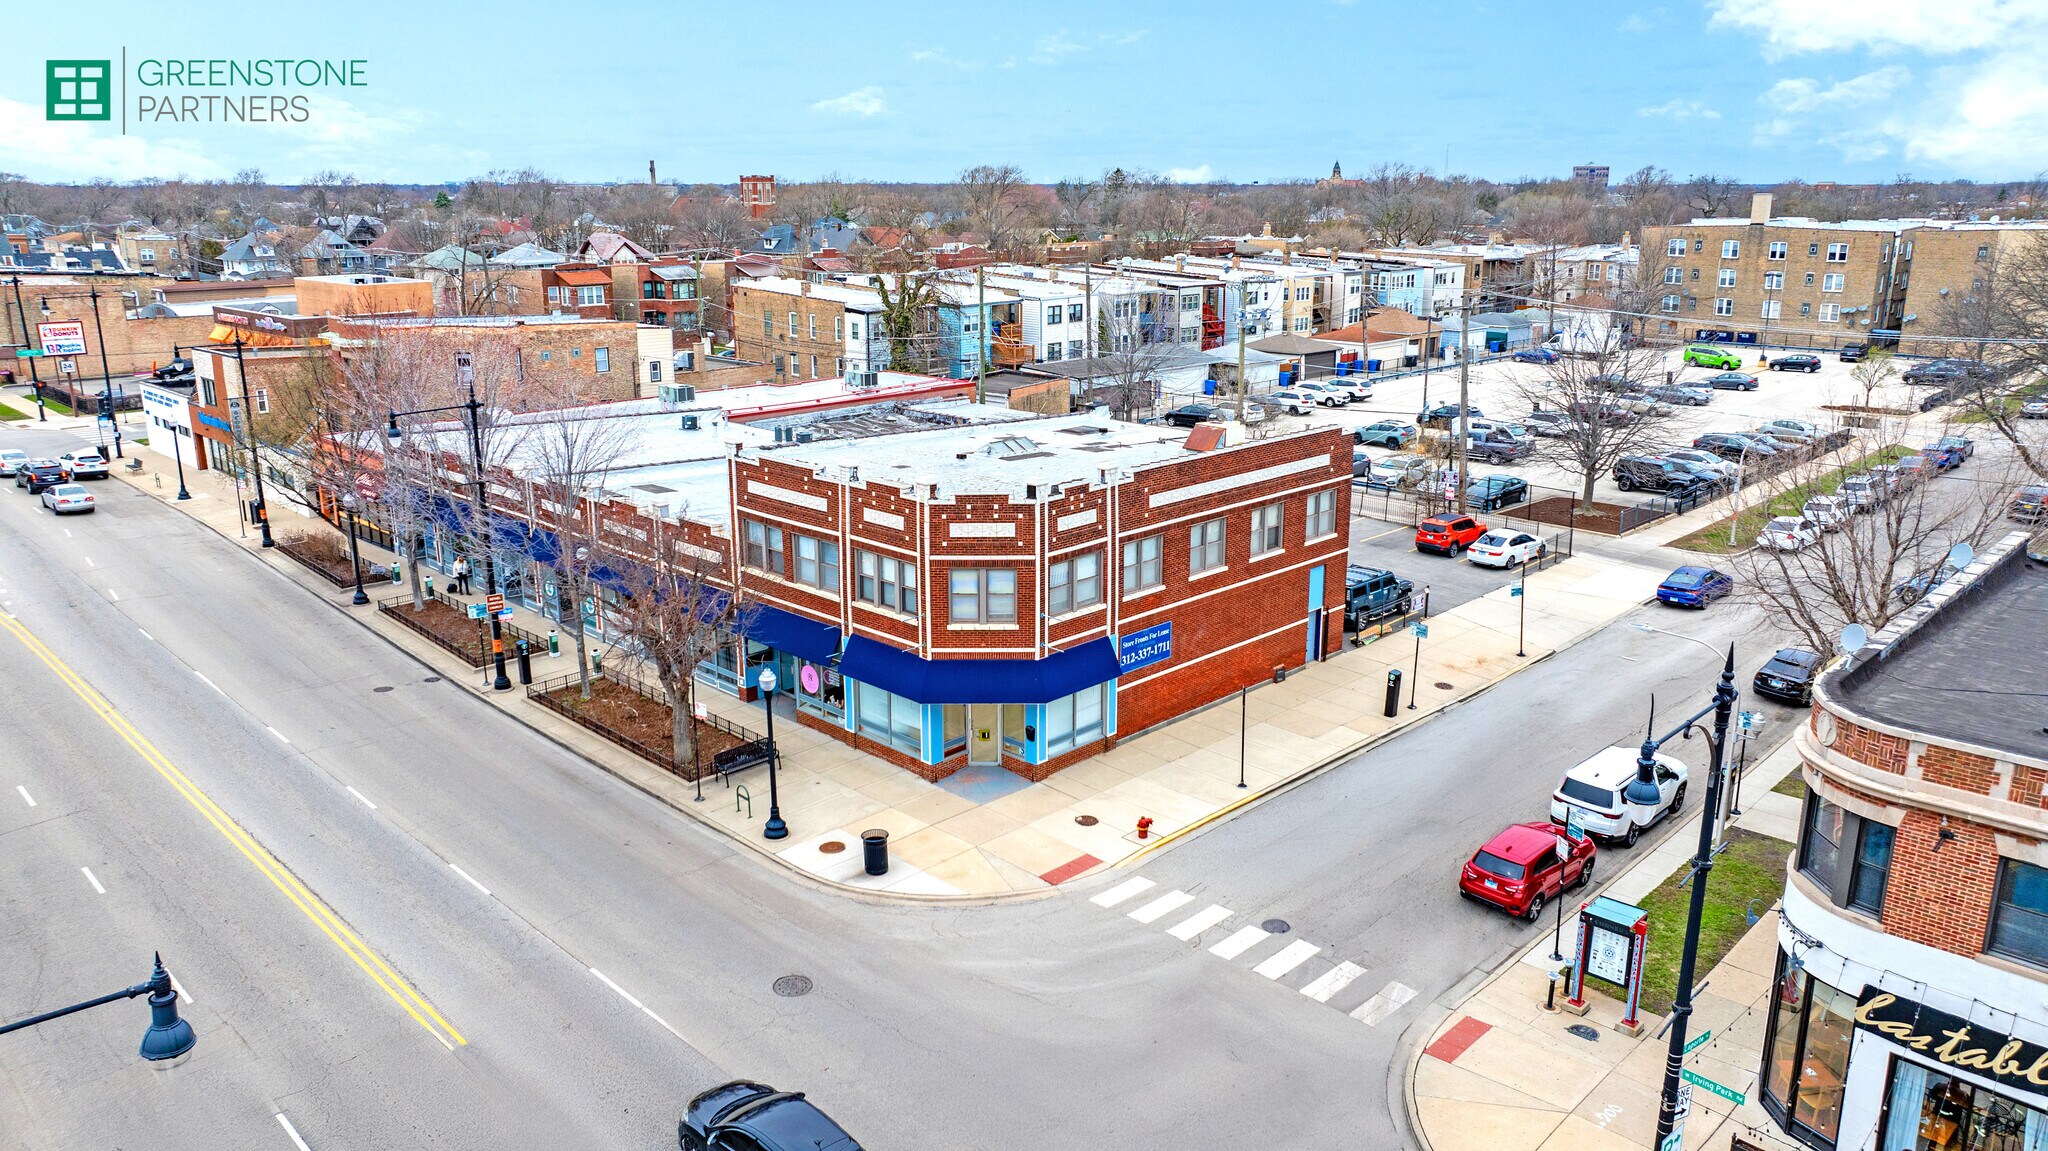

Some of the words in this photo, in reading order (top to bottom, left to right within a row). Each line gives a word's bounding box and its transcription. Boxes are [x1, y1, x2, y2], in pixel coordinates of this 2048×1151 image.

[1135, 636, 1148, 644] Fronts
[1121, 641, 1170, 666] 312-337-1711
[1692, 1074, 1715, 1092] Irving
[1715, 1085, 1734, 1099] Park
